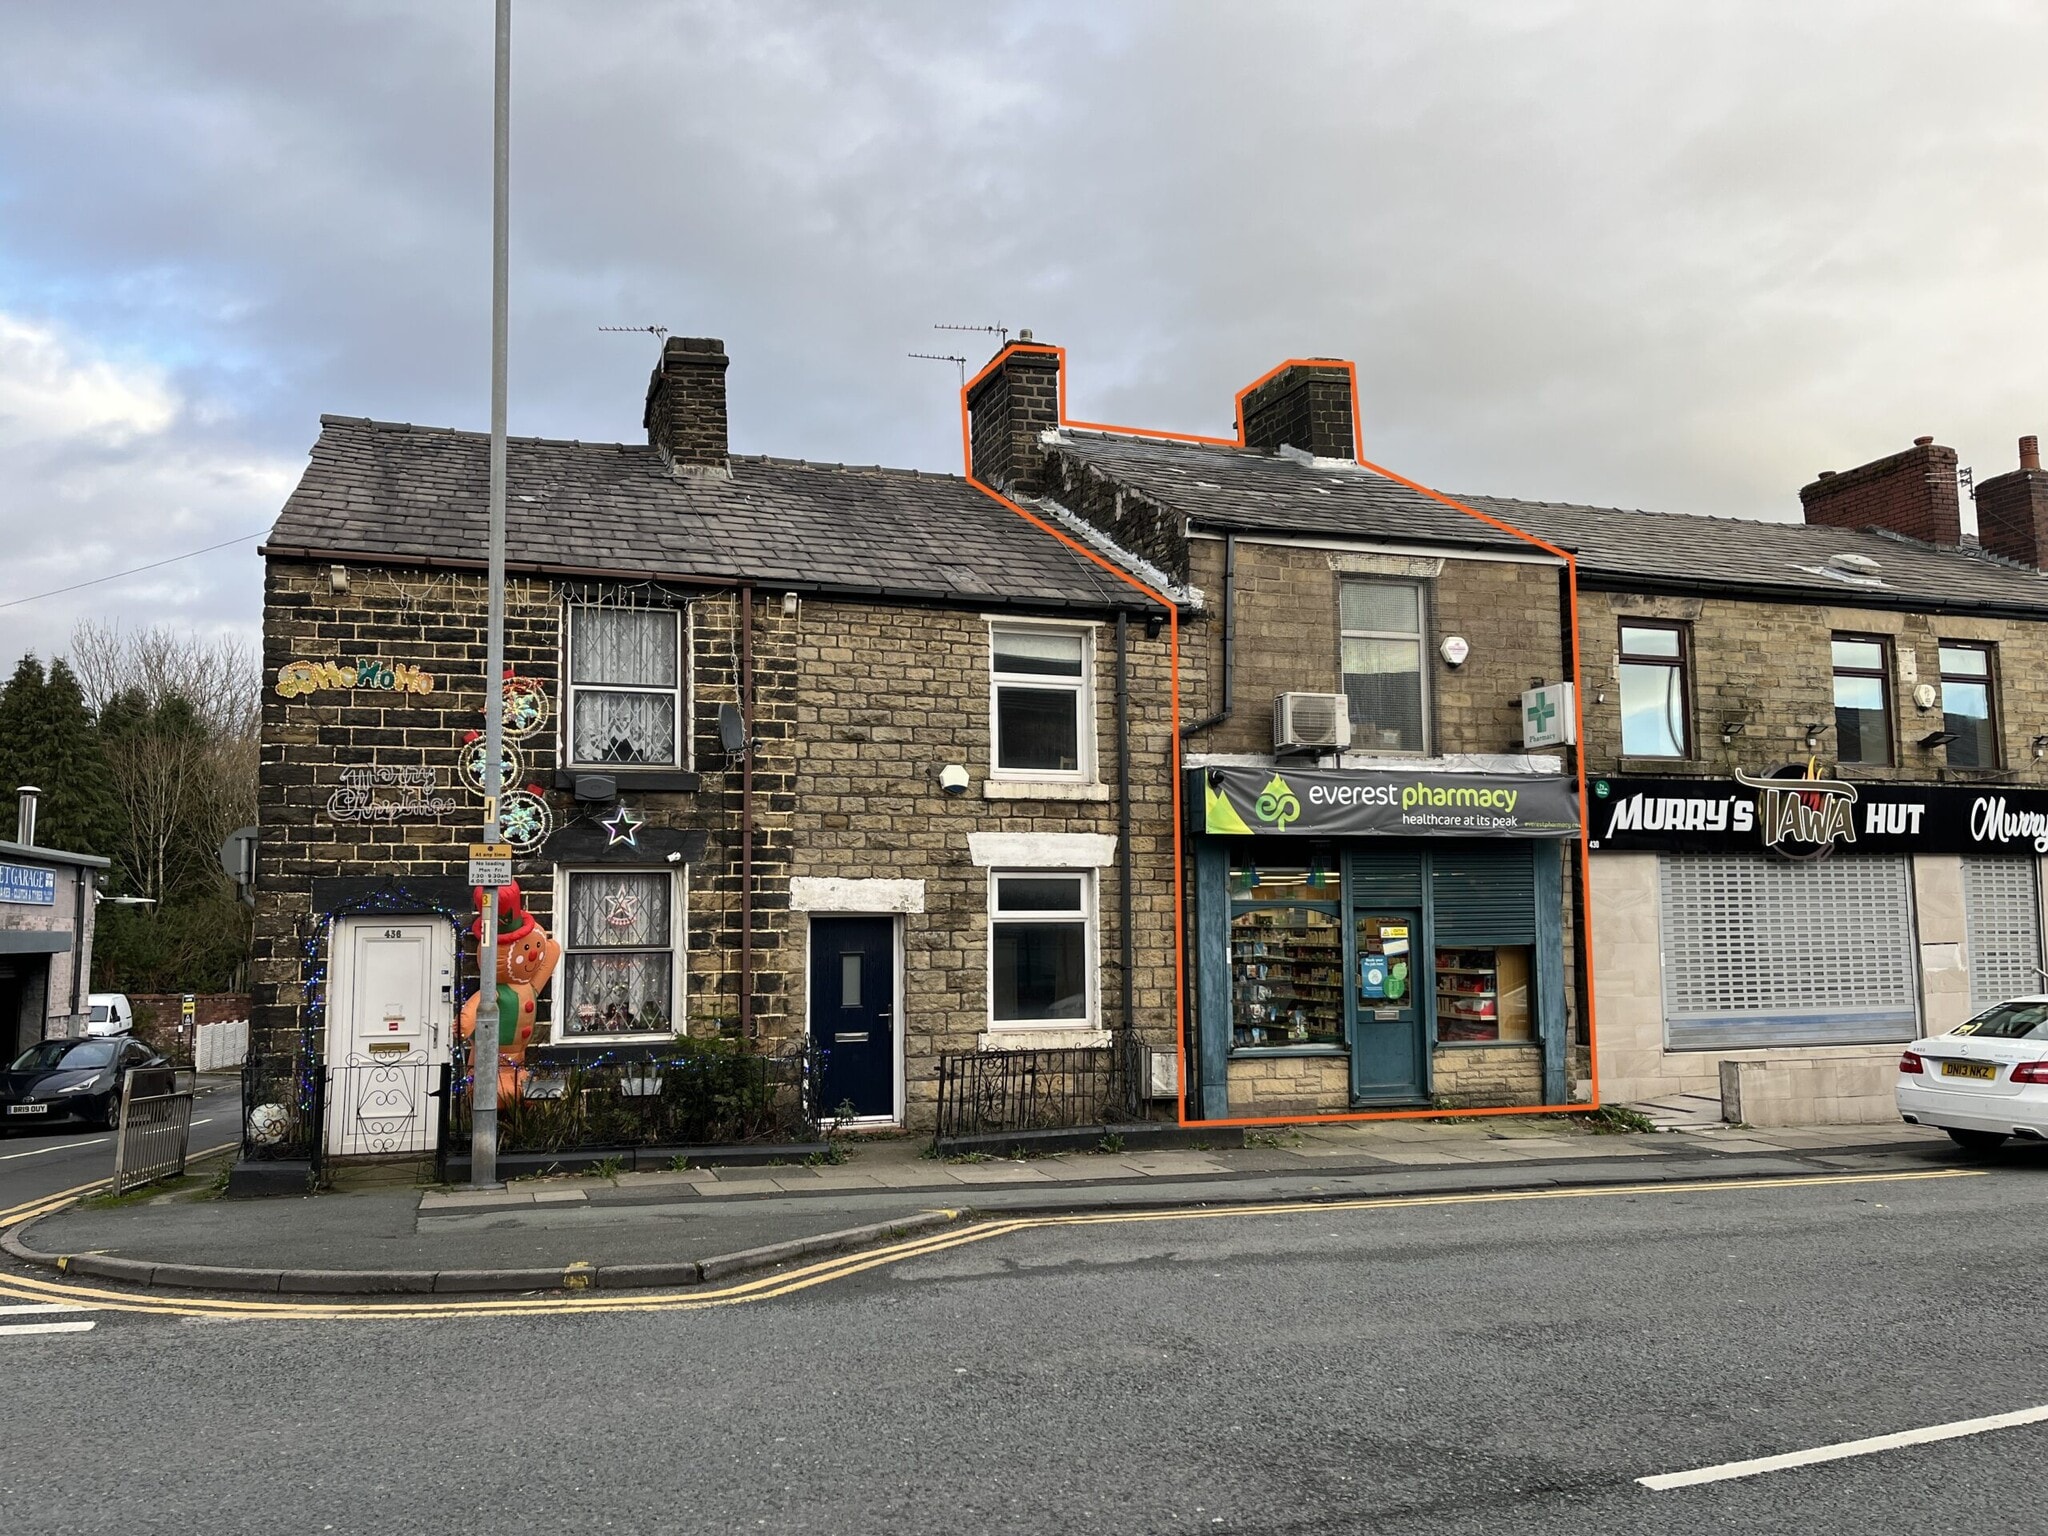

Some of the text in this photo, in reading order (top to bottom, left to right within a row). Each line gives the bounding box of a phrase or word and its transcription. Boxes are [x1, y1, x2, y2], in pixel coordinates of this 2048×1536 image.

[1529, 733, 1556, 742] Pharmacy
[340, 766, 436, 794] Merry
[327, 787, 457, 821] Christmas
[1309, 782, 1517, 813] everest pharmacy
[1403, 813, 1518, 828] healthcare at its peak
[1865, 803, 1925, 834] HUT
[1589, 840, 1600, 848] 430
[11, 868, 44, 888] GARAGE
[384, 930, 401, 939] 436
[1946, 1063, 1990, 1078] DN13 NKZ
